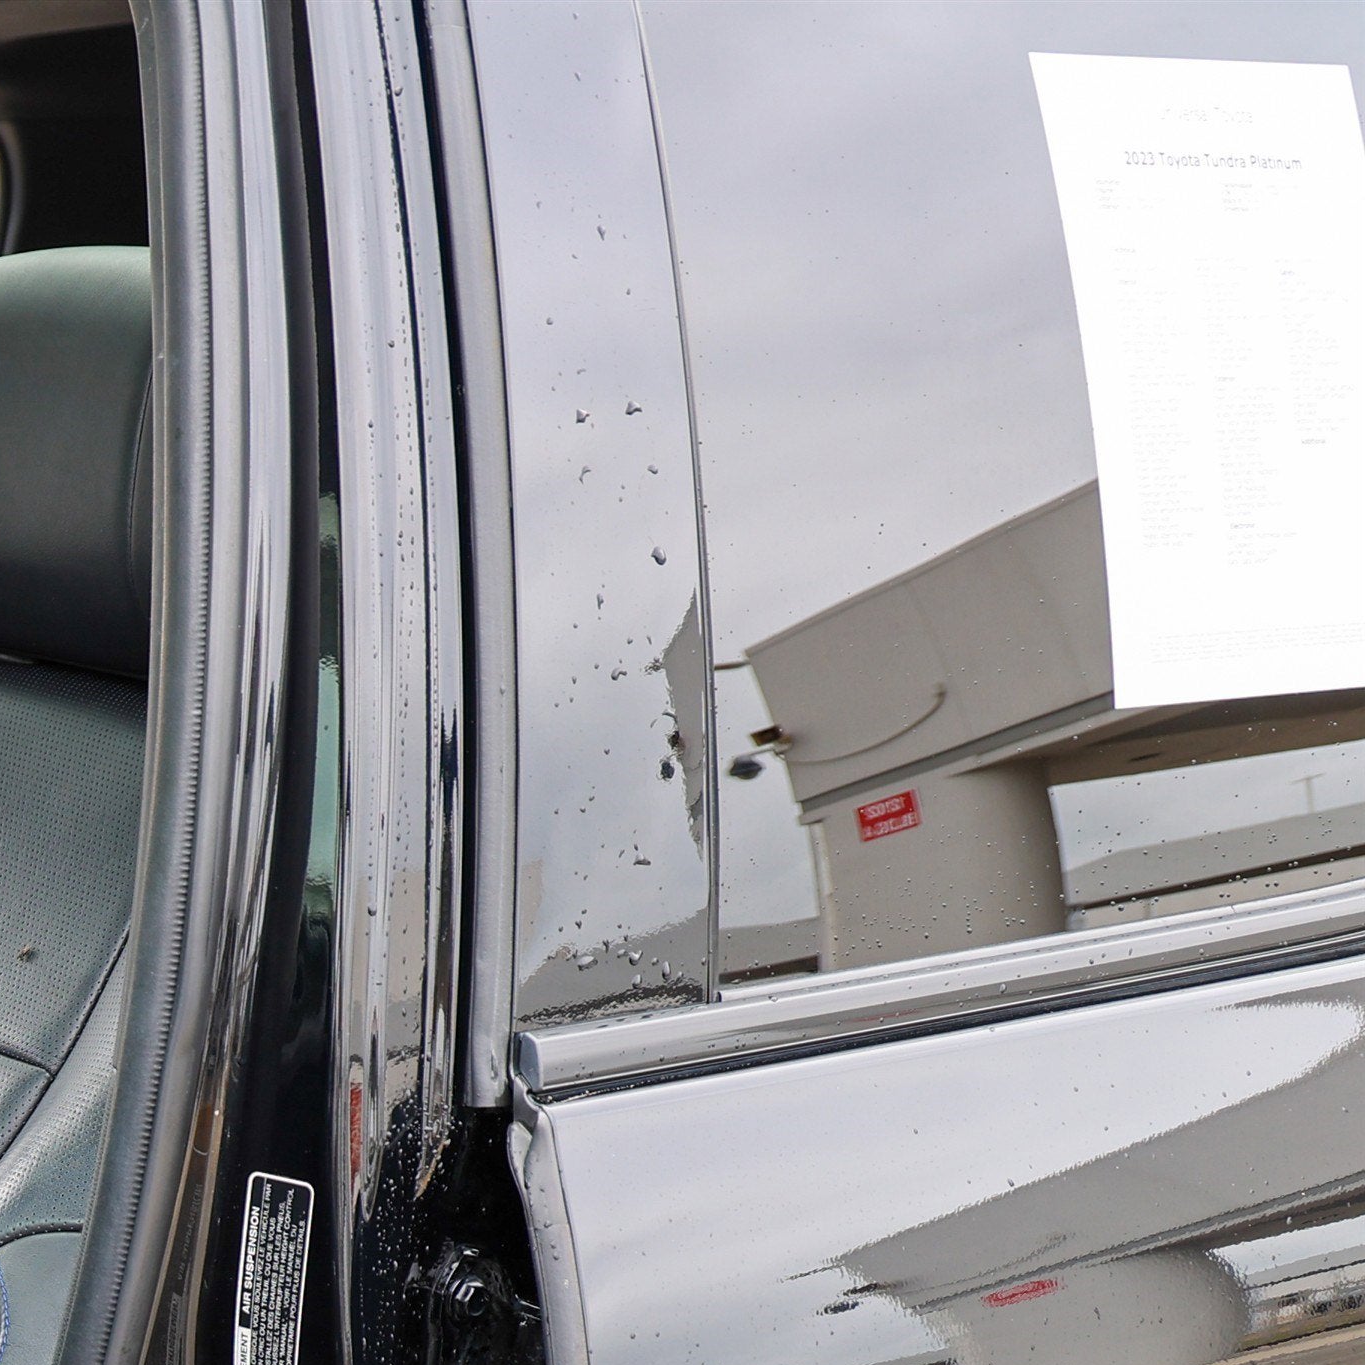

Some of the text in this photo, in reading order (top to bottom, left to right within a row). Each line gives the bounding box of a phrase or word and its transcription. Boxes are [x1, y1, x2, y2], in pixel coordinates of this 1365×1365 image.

[1125, 150, 1302, 171] 2023 Toyota Tundra Platinum
[284, 1189, 294, 1229] CONTROL
[268, 1217, 276, 1241] VOUS
[242, 1207, 259, 1314] AIR SUSPENSION
[259, 1247, 265, 1257] LE
[286, 1276, 292, 1286] LE
[291, 1224, 297, 1237] DU
[264, 1263, 271, 1276] OU
[295, 1257, 301, 1269] DE
[292, 1271, 300, 1292] PLUS
[261, 1309, 266, 1321] UN
[260, 1323, 266, 1336] OU
